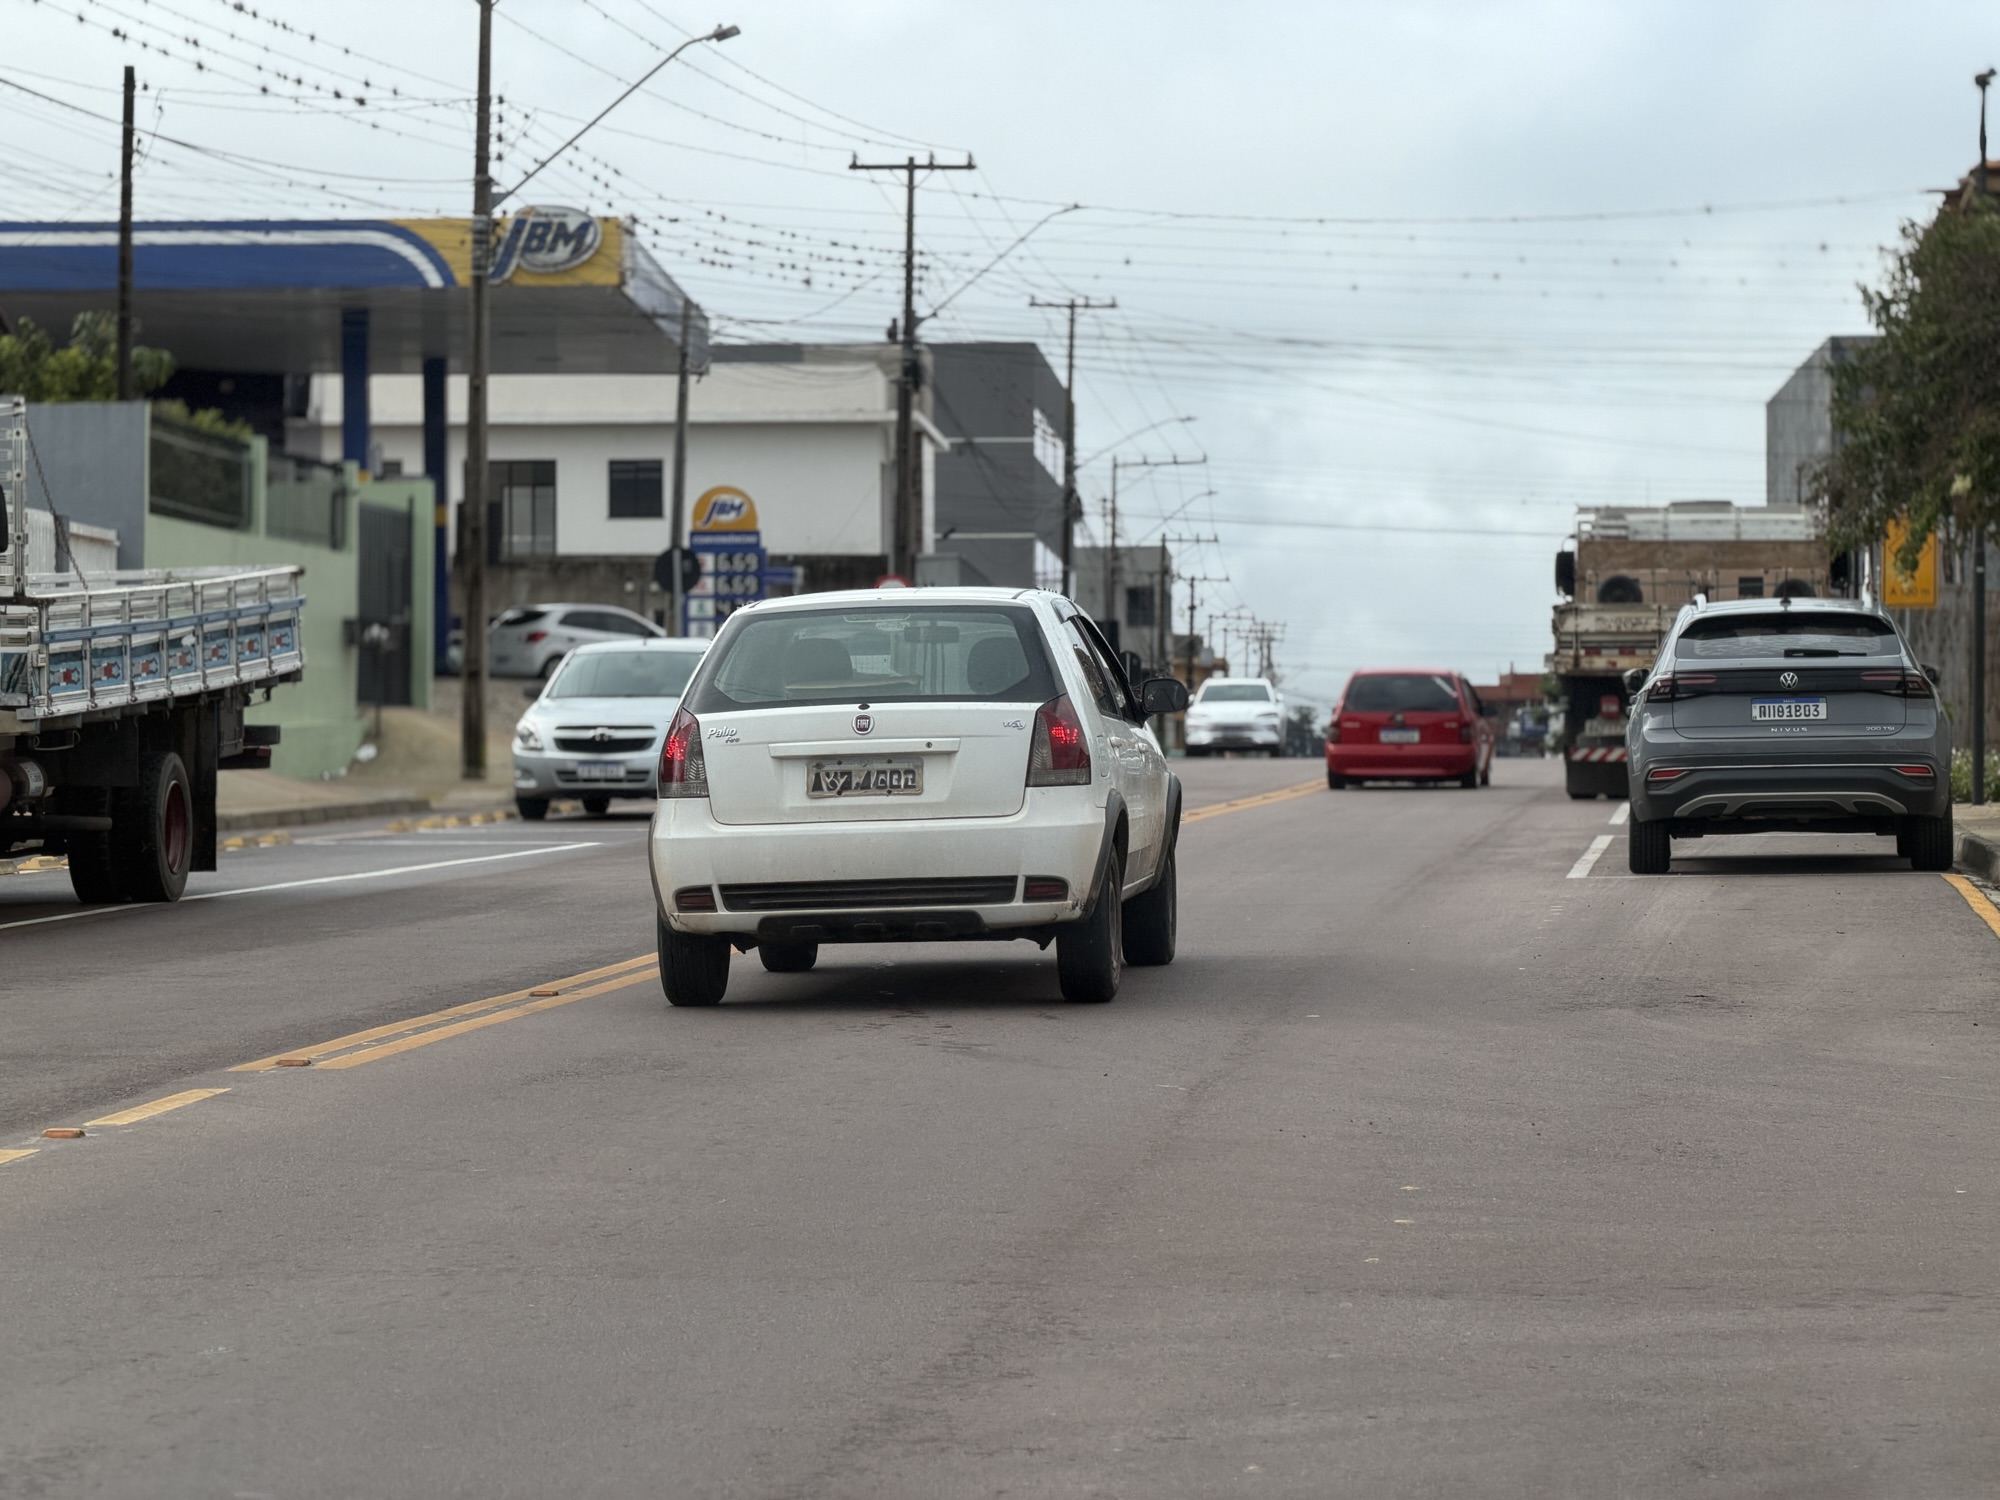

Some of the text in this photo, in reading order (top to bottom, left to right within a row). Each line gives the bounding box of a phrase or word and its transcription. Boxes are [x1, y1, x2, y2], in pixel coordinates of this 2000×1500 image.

[488, 217, 595, 281] JBM
[703, 500, 745, 526] JBM
[707, 726, 737, 739] Palio
[857, 719, 870, 729] FIAT
